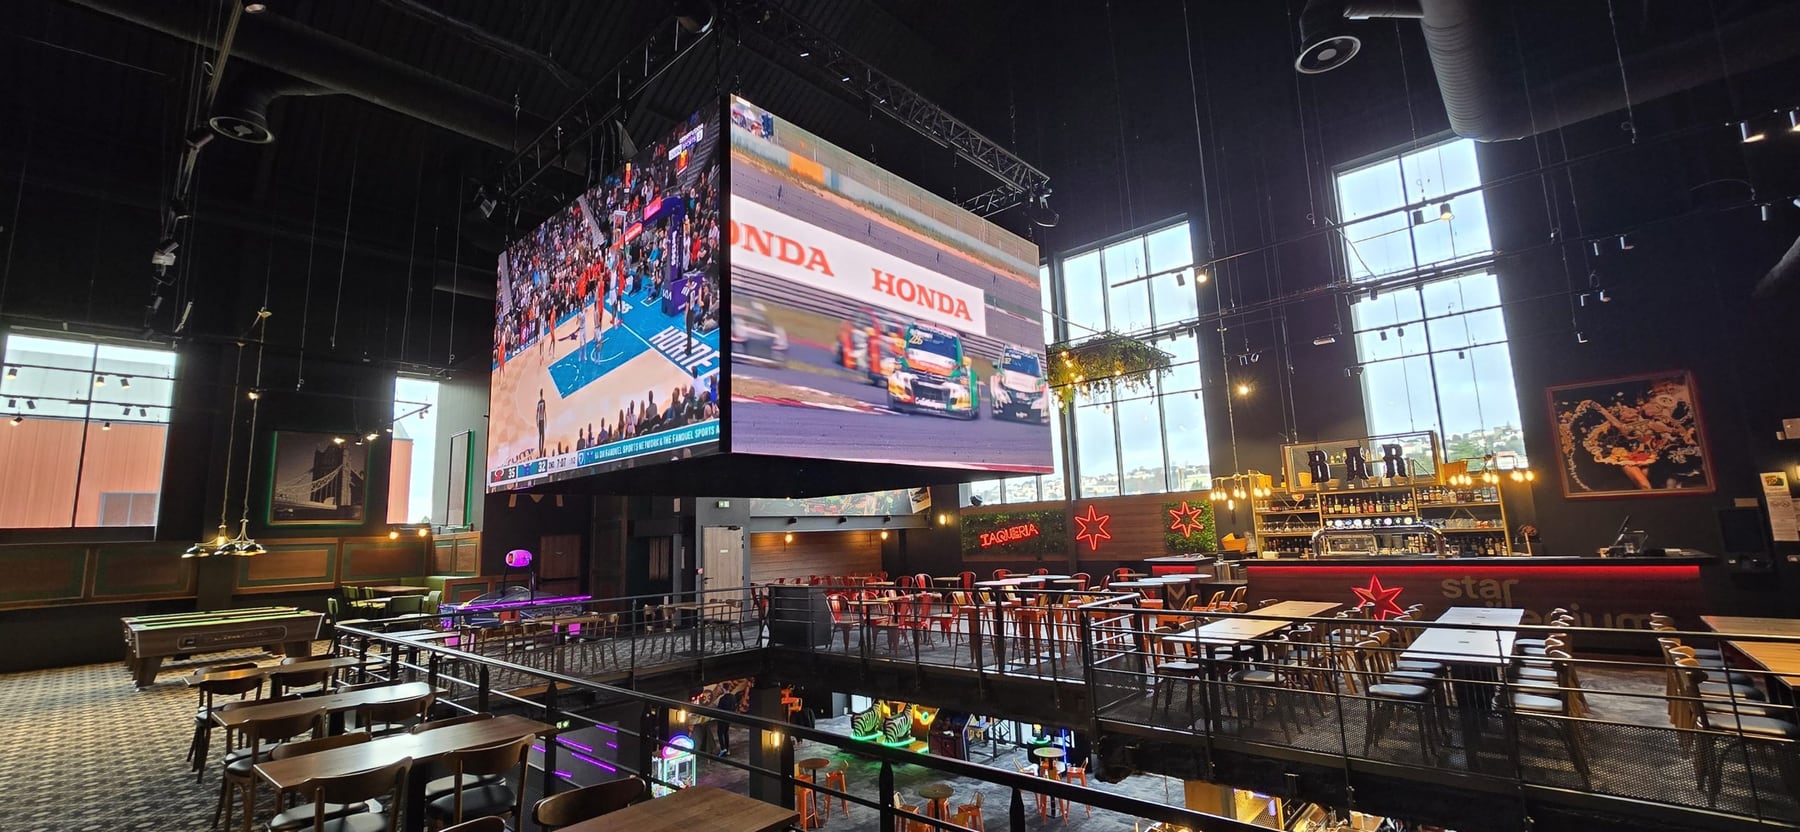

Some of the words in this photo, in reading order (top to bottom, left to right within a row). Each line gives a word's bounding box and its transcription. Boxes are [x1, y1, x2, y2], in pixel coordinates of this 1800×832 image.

[871, 268, 973, 322] HONDA
[622, 444, 639, 454] SPORTS
[639, 440, 659, 451] NETWORK
[663, 436, 672, 445] THE
[672, 433, 693, 443] FANDUEL
[695, 429, 715, 439] SPORTS
[508, 466, 515, 478] 35
[538, 460, 546, 472] 32
[1307, 444, 1408, 483] BAR
[980, 523, 1039, 547] TAQUERIA
[1441, 575, 1519, 608] star
